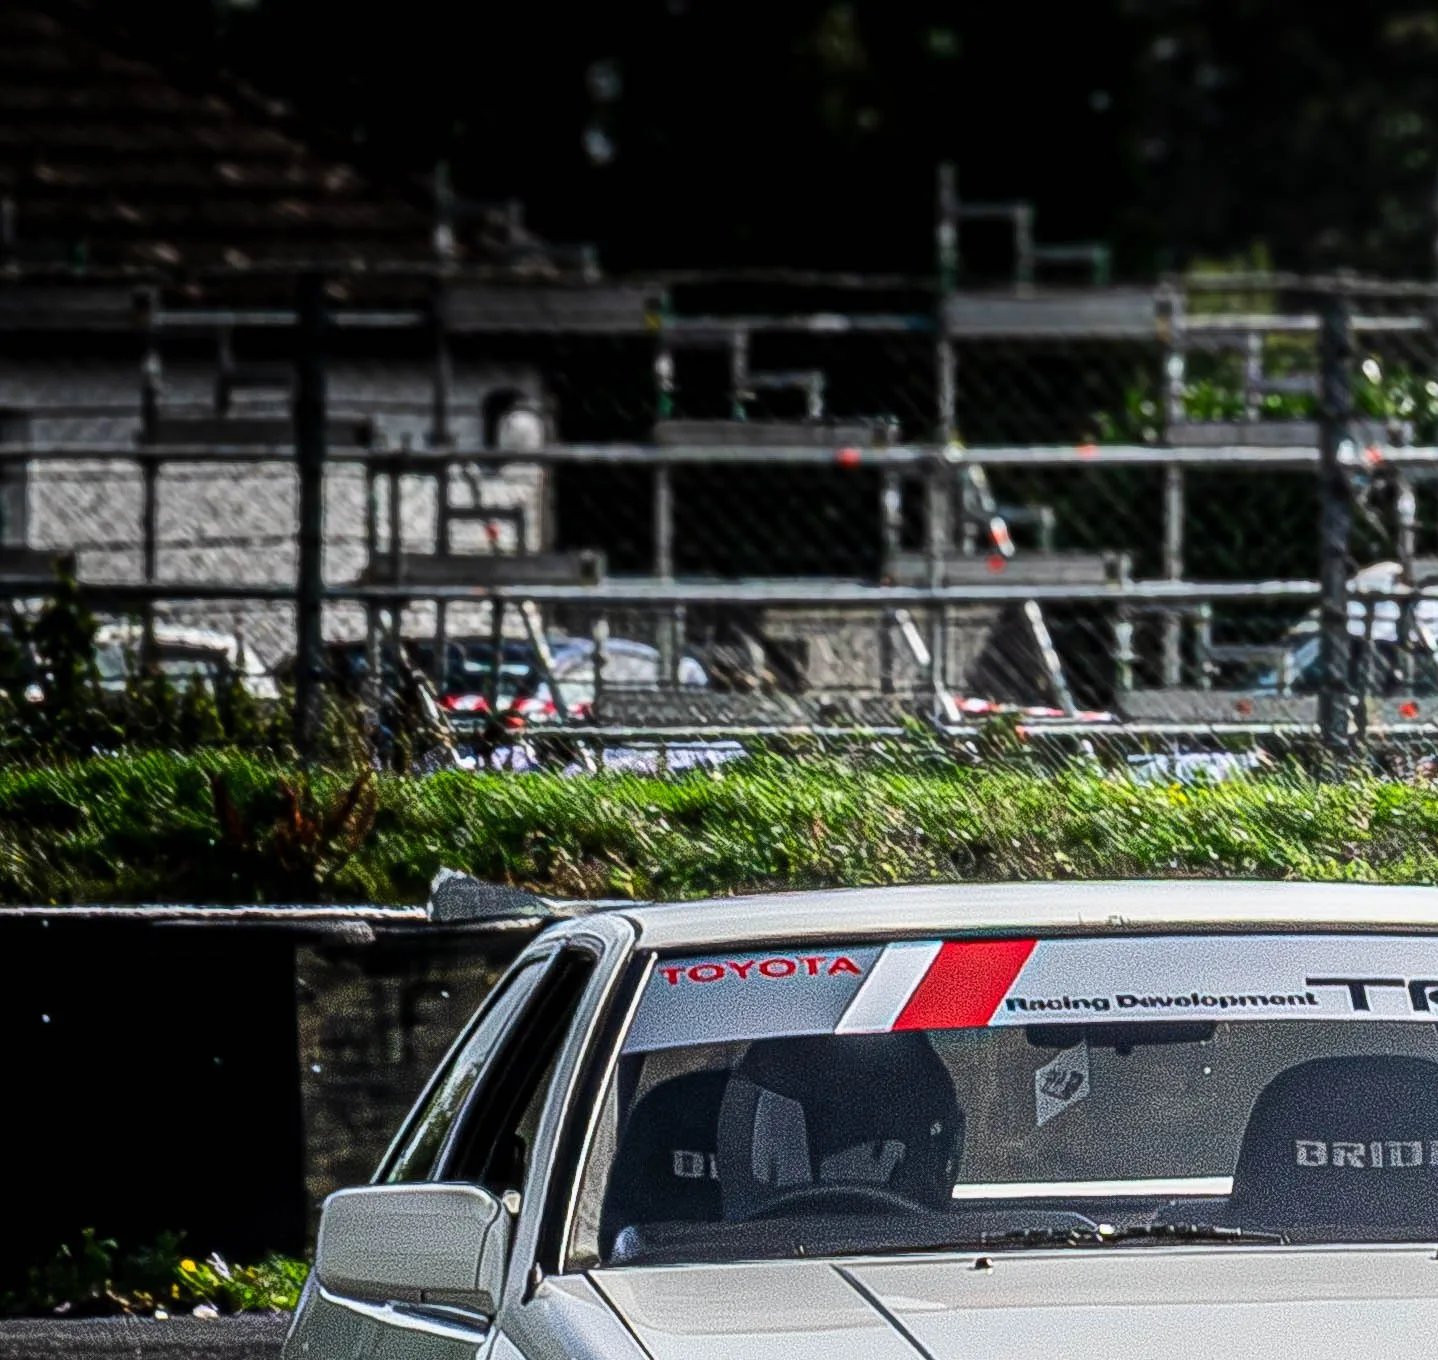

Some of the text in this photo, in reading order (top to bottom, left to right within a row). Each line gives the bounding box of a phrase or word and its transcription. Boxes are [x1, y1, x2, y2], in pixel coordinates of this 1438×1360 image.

[660, 956, 862, 986] TOYOTA
[1005, 994, 1111, 1013] Racing
[1115, 990, 1319, 1010] Development
